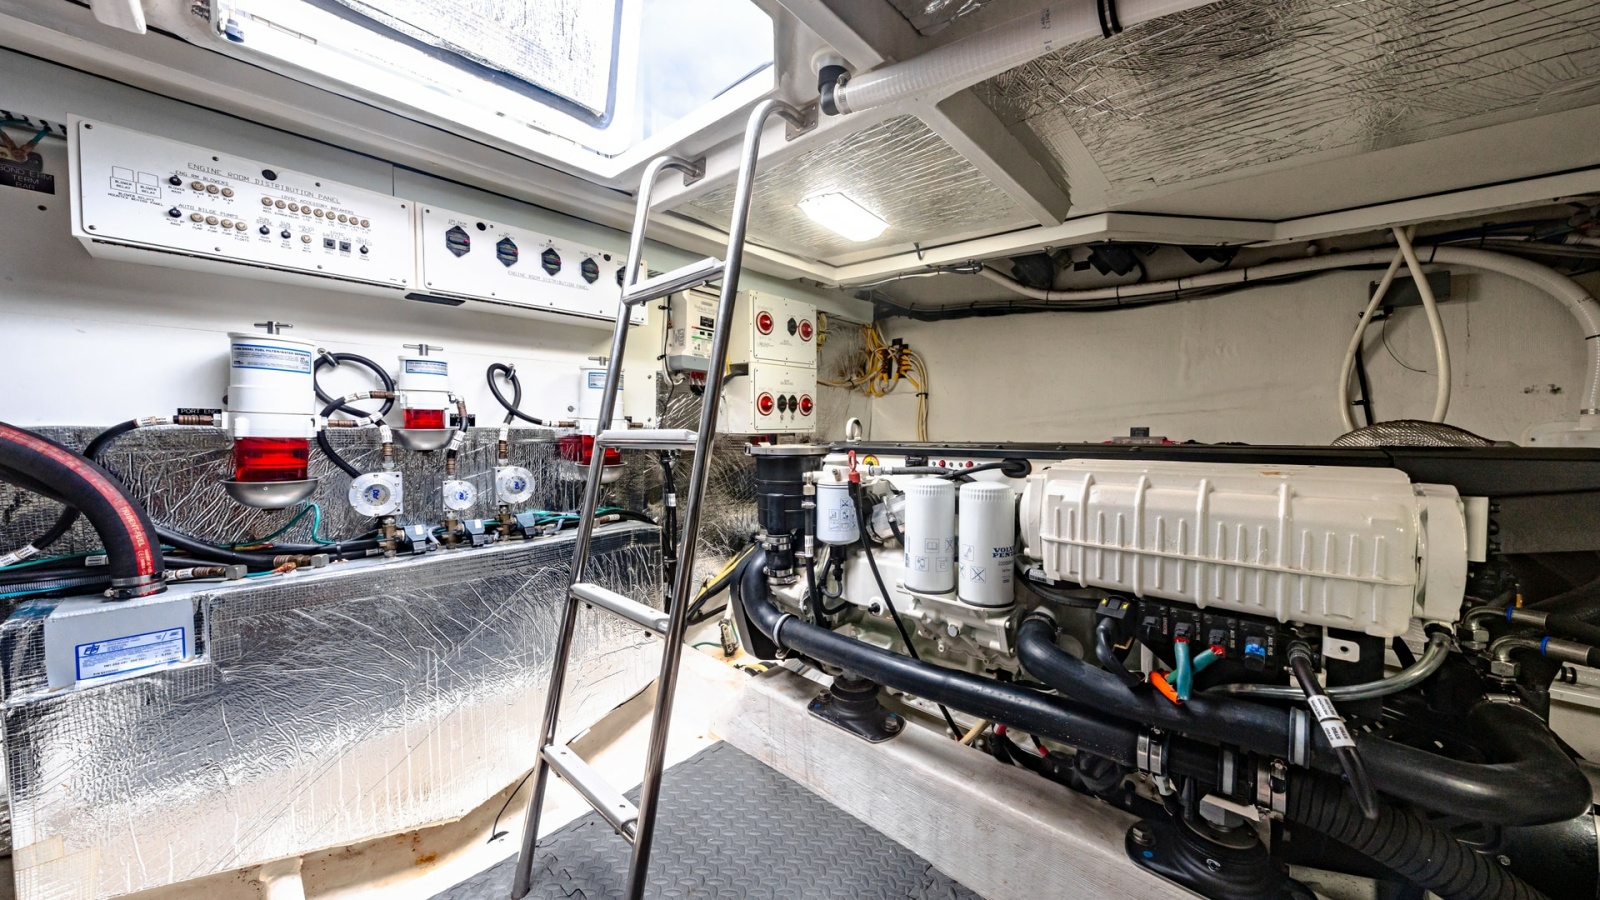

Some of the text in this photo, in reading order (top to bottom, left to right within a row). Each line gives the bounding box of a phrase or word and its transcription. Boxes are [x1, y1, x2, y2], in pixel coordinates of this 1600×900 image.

[12, 174, 40, 185] TERM
[187, 162, 341, 204] ENGINE ROOM DISTRIBUTION PANEL
[203, 177, 229, 186] BLOWERS
[178, 203, 195, 211] AUTO
[299, 199, 328, 210] ACCESSORY
[331, 206, 354, 215] BREAKERS
